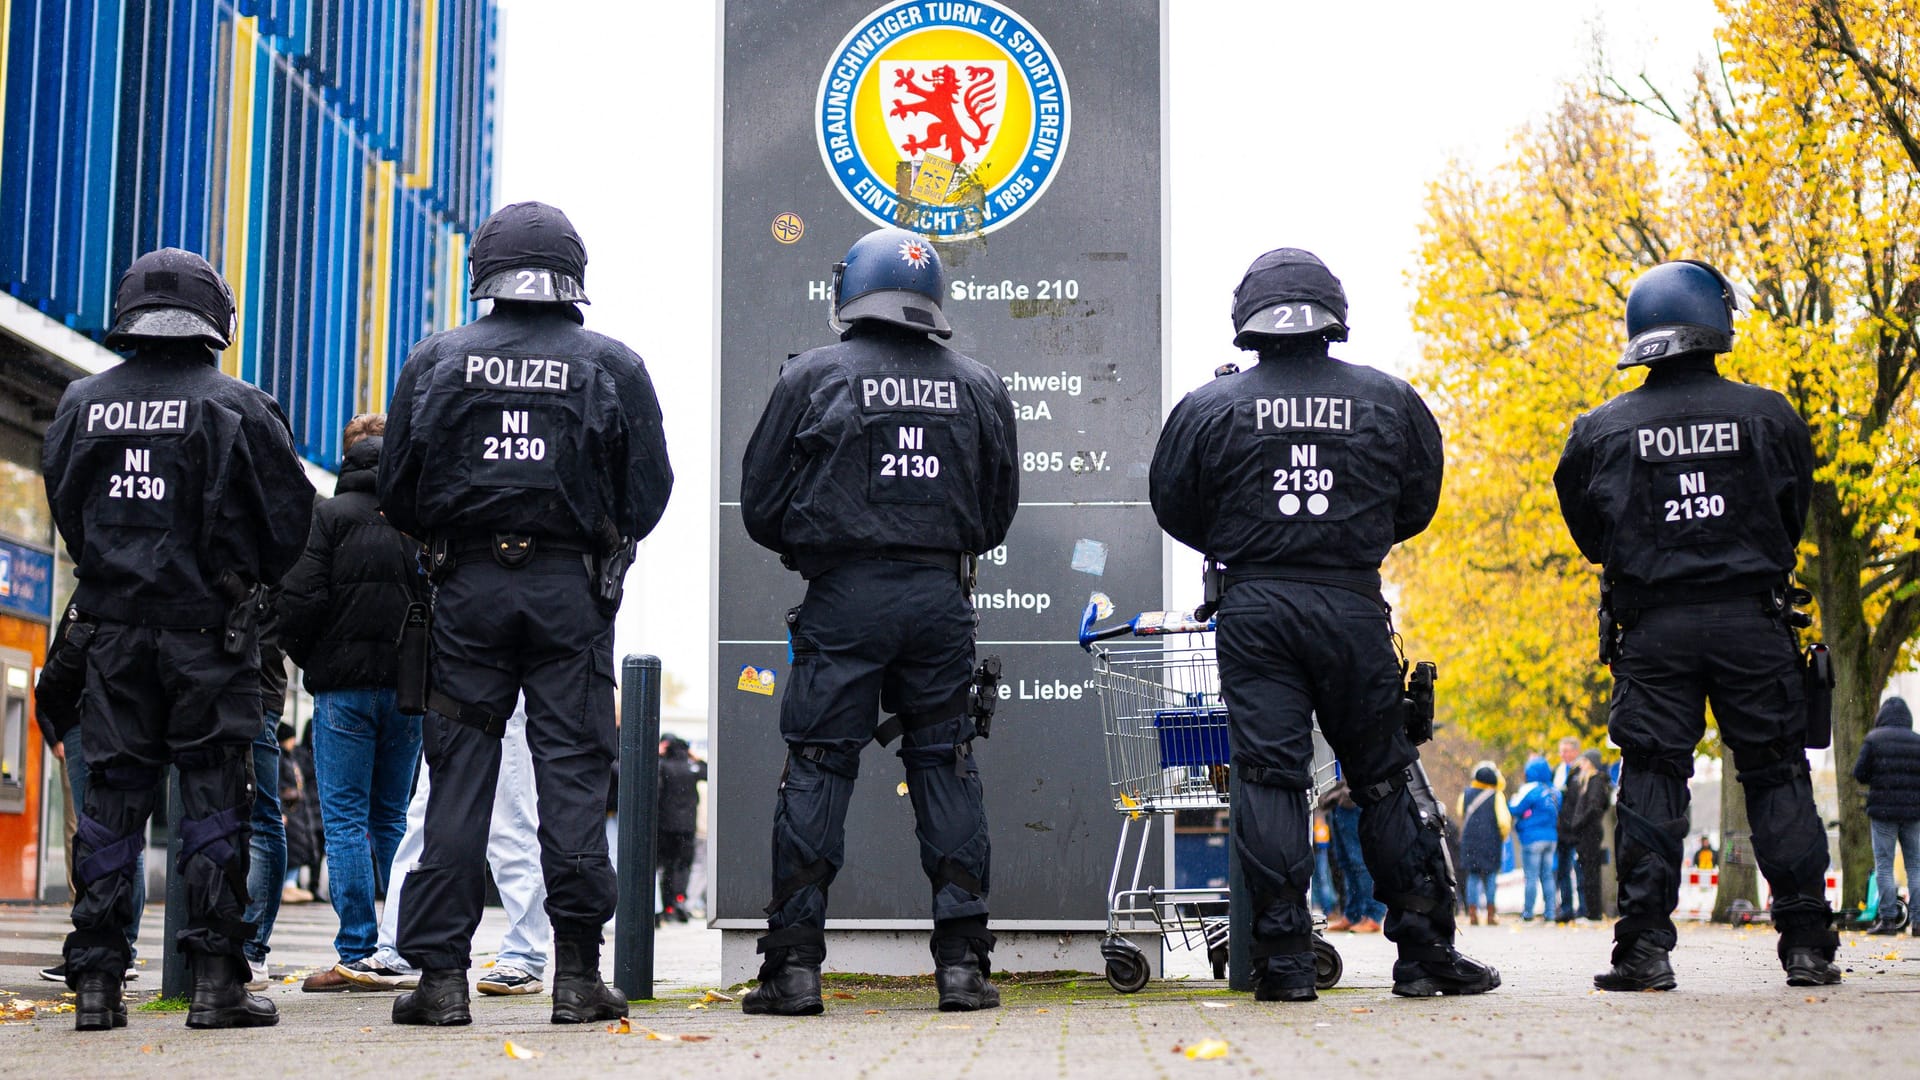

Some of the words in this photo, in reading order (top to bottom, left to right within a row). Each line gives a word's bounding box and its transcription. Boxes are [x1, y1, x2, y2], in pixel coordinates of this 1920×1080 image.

[827, 5, 923, 165] BRAUNSCHWEIGER
[925, 1, 988, 26] TURN-
[990, 15, 1005, 39] U.
[1007, 29, 1060, 161] SPORTVEREIN
[853, 177, 960, 231] EINTRACHT
[994, 174, 1035, 212] 1895
[515, 270, 551, 296] 21
[950, 279, 1030, 301] Straße
[1036, 280, 1079, 300] 210
[1272, 304, 1314, 329] 21
[1641, 343, 1660, 356] 37
[465, 355, 569, 391] POLIZEI
[1001, 371, 1082, 396] chweig
[862, 377, 957, 409] POLIZEI
[87, 400, 187, 432] POLIZEI
[502, 410, 529, 434] NI
[1255, 397, 1351, 431] POLIZEI
[483, 436, 546, 461] 2130
[898, 426, 924, 450] NI
[1638, 422, 1739, 457] POLIZEI
[125, 448, 150, 473] NI
[880, 453, 940, 478] 2130
[1022, 451, 1064, 472] 895
[1069, 450, 1111, 472] e.V.
[1291, 444, 1317, 467] NI
[108, 474, 165, 501] 2130
[1273, 469, 1334, 492] 2130
[1679, 471, 1706, 496] NI
[1664, 494, 1726, 522] 2130
[972, 588, 1051, 614] nshop
